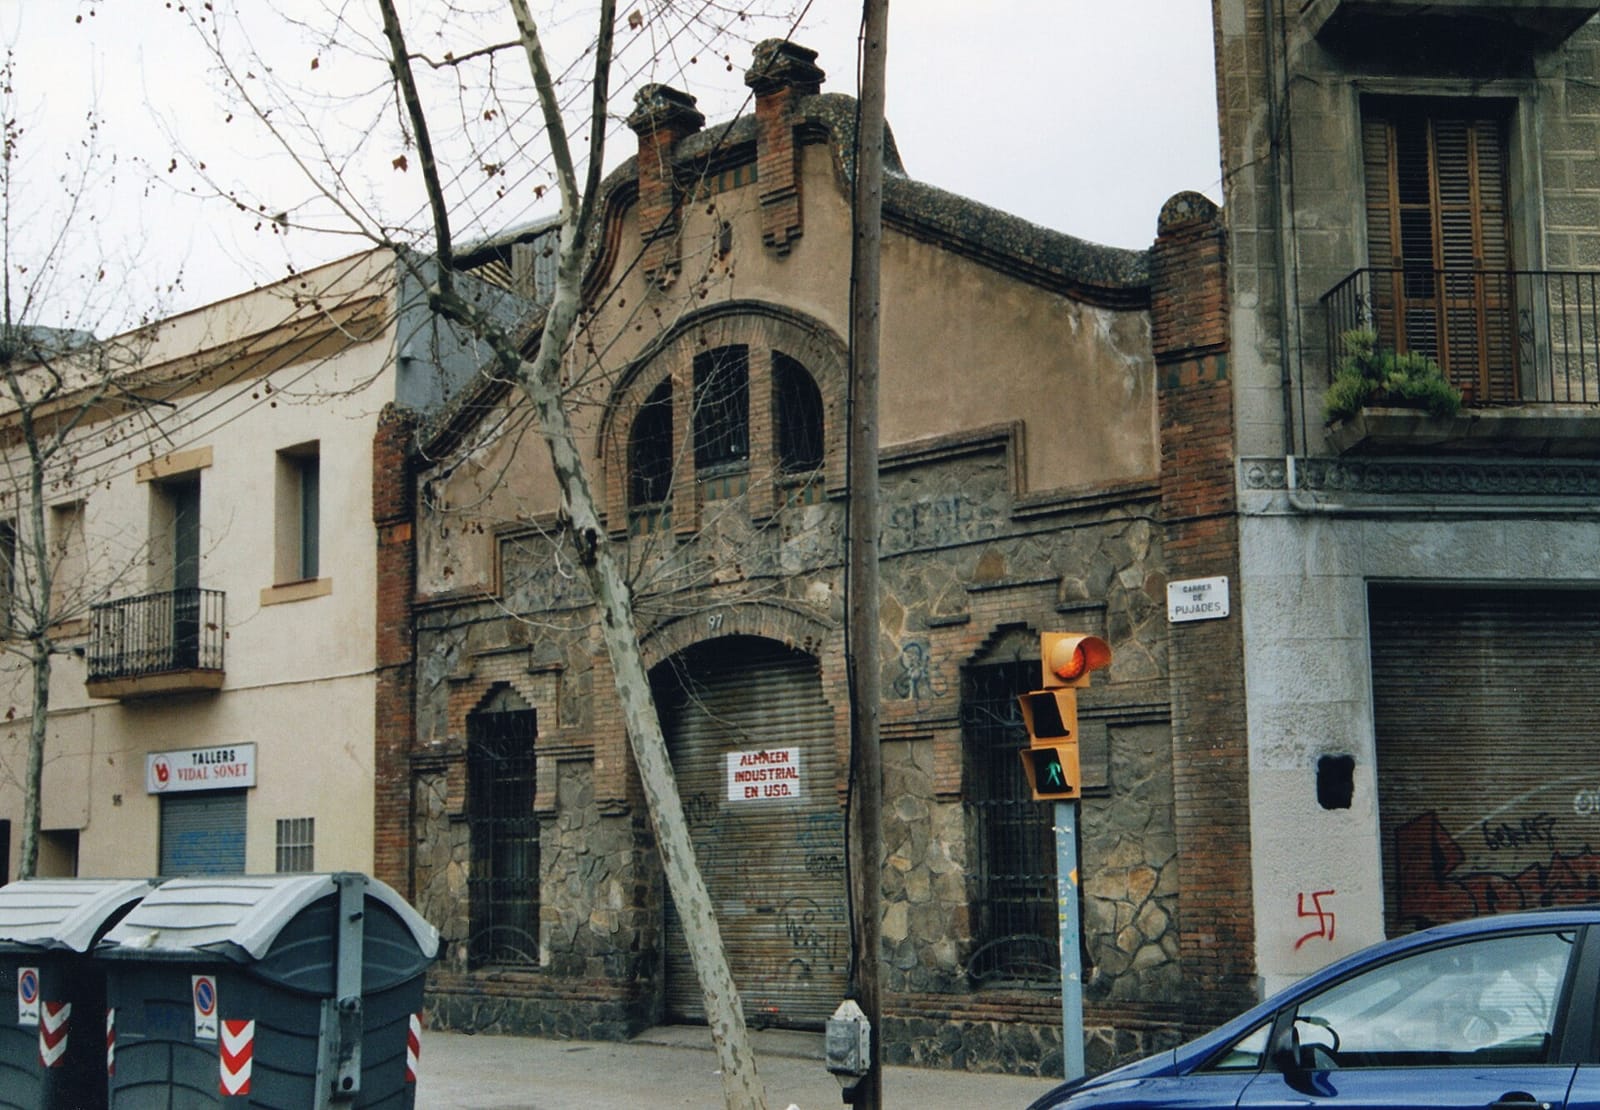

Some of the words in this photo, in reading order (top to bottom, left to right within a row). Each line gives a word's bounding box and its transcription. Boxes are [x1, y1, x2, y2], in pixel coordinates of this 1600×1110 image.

[1182, 584, 1212, 593] CARRER
[1192, 593, 1203, 602] DE
[1175, 602, 1221, 615] PUJADES
[708, 614, 723, 630] 97
[192, 749, 235, 765] TALLERS
[740, 751, 789, 766] ALMACEN
[177, 766, 208, 781] VIDAL
[213, 763, 248, 779] SONET
[734, 766, 800, 783] INDUSTRIAL
[744, 786, 759, 798] EN
[764, 783, 792, 797] USO.
